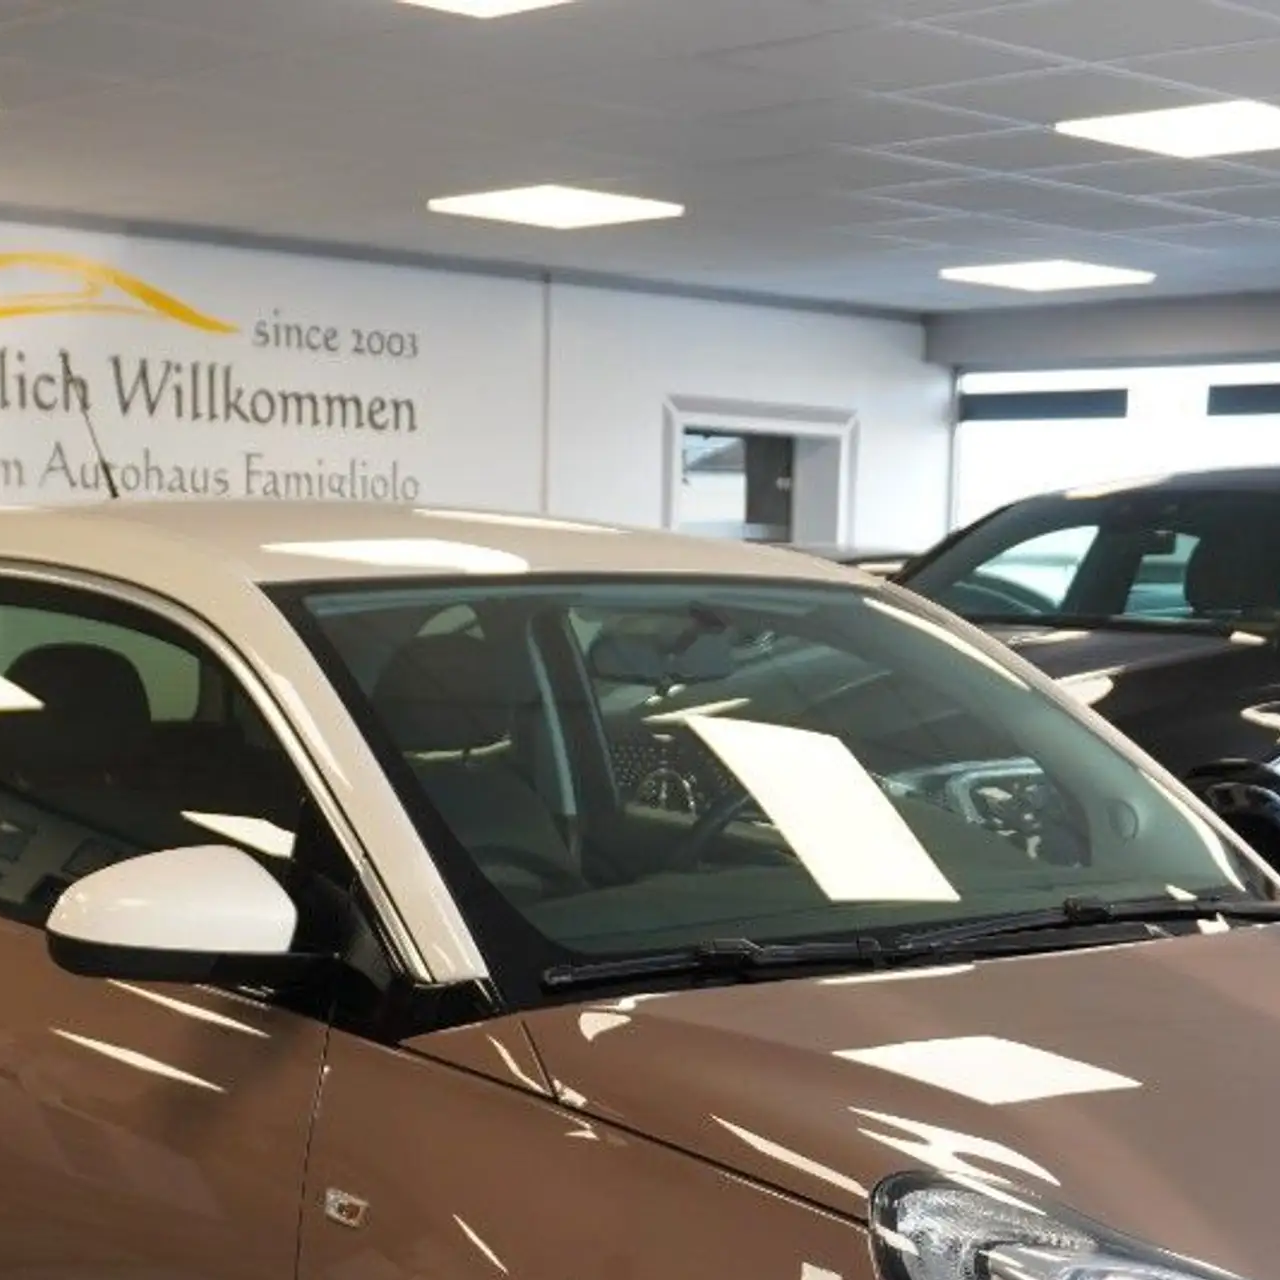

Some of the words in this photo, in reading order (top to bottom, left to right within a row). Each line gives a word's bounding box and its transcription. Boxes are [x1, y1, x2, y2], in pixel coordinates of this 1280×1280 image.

[253, 308, 340, 351] since
[351, 327, 419, 358] 2003
[108, 354, 418, 432] Willkommen
[242, 451, 420, 501] Famigliolo
